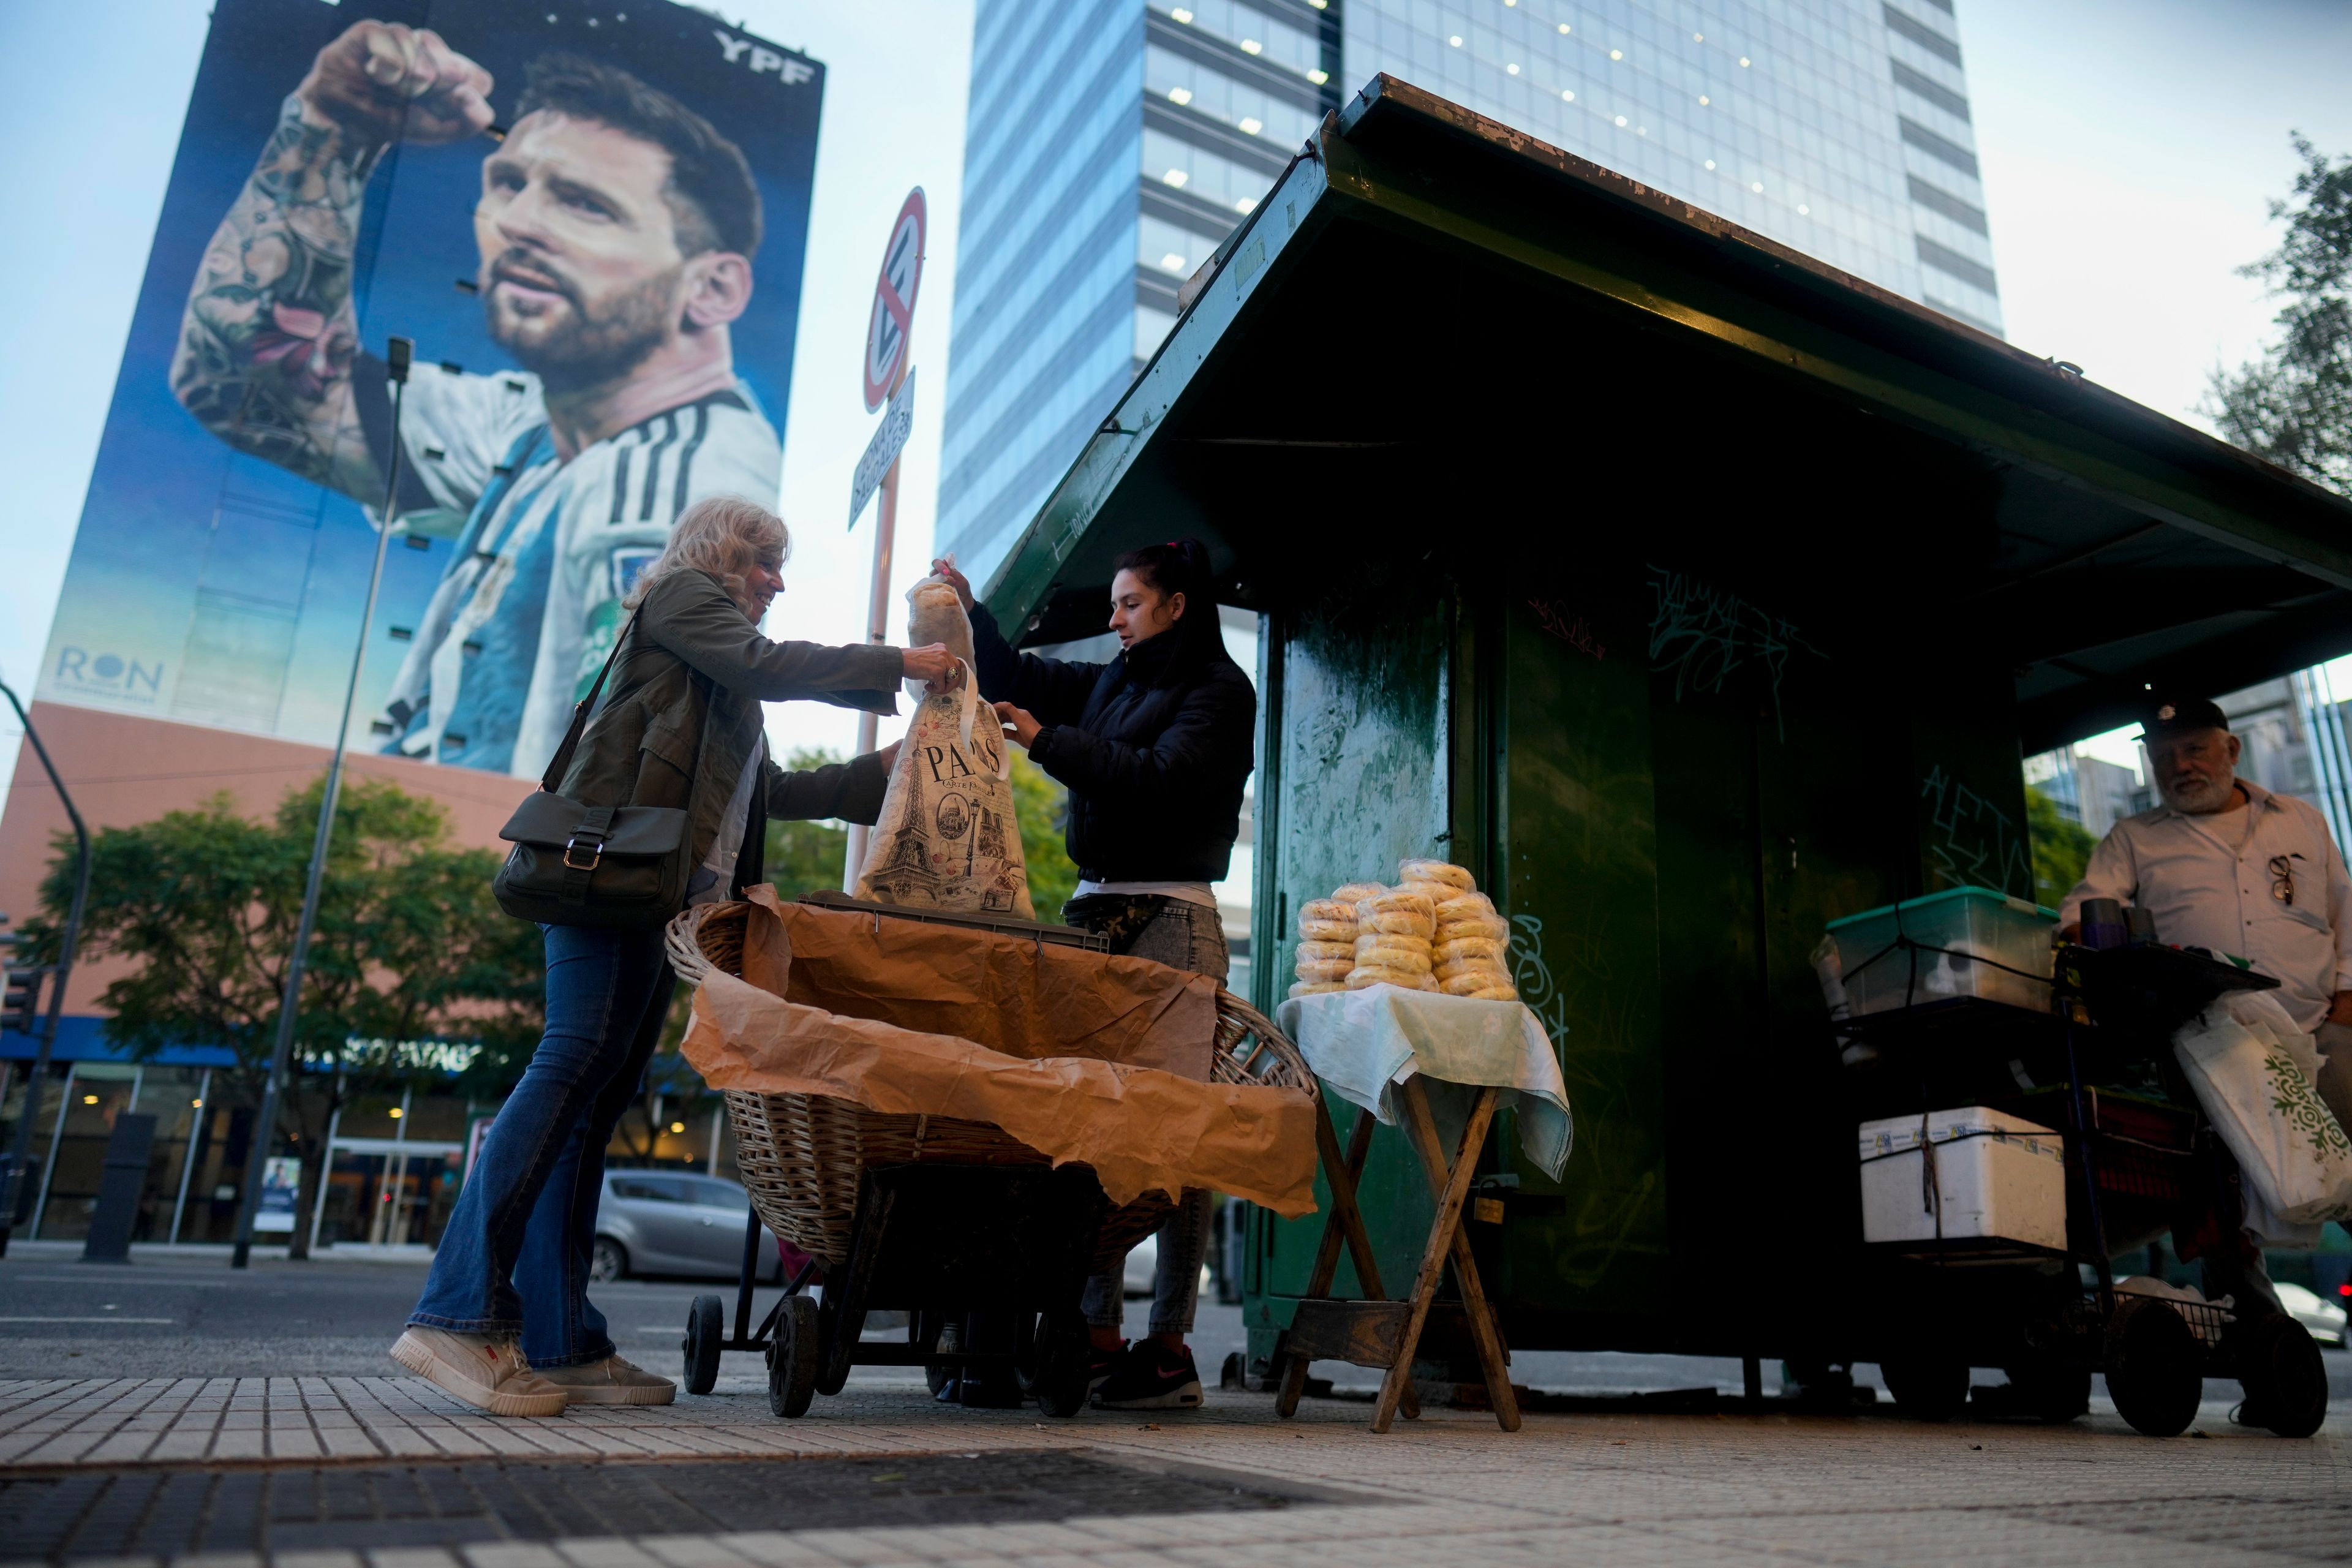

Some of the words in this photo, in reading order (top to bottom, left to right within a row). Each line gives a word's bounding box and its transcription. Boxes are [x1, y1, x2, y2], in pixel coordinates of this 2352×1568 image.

[713, 29, 815, 86] YPF
[861, 428, 886, 483] ZONA
[888, 396, 902, 435] DE
